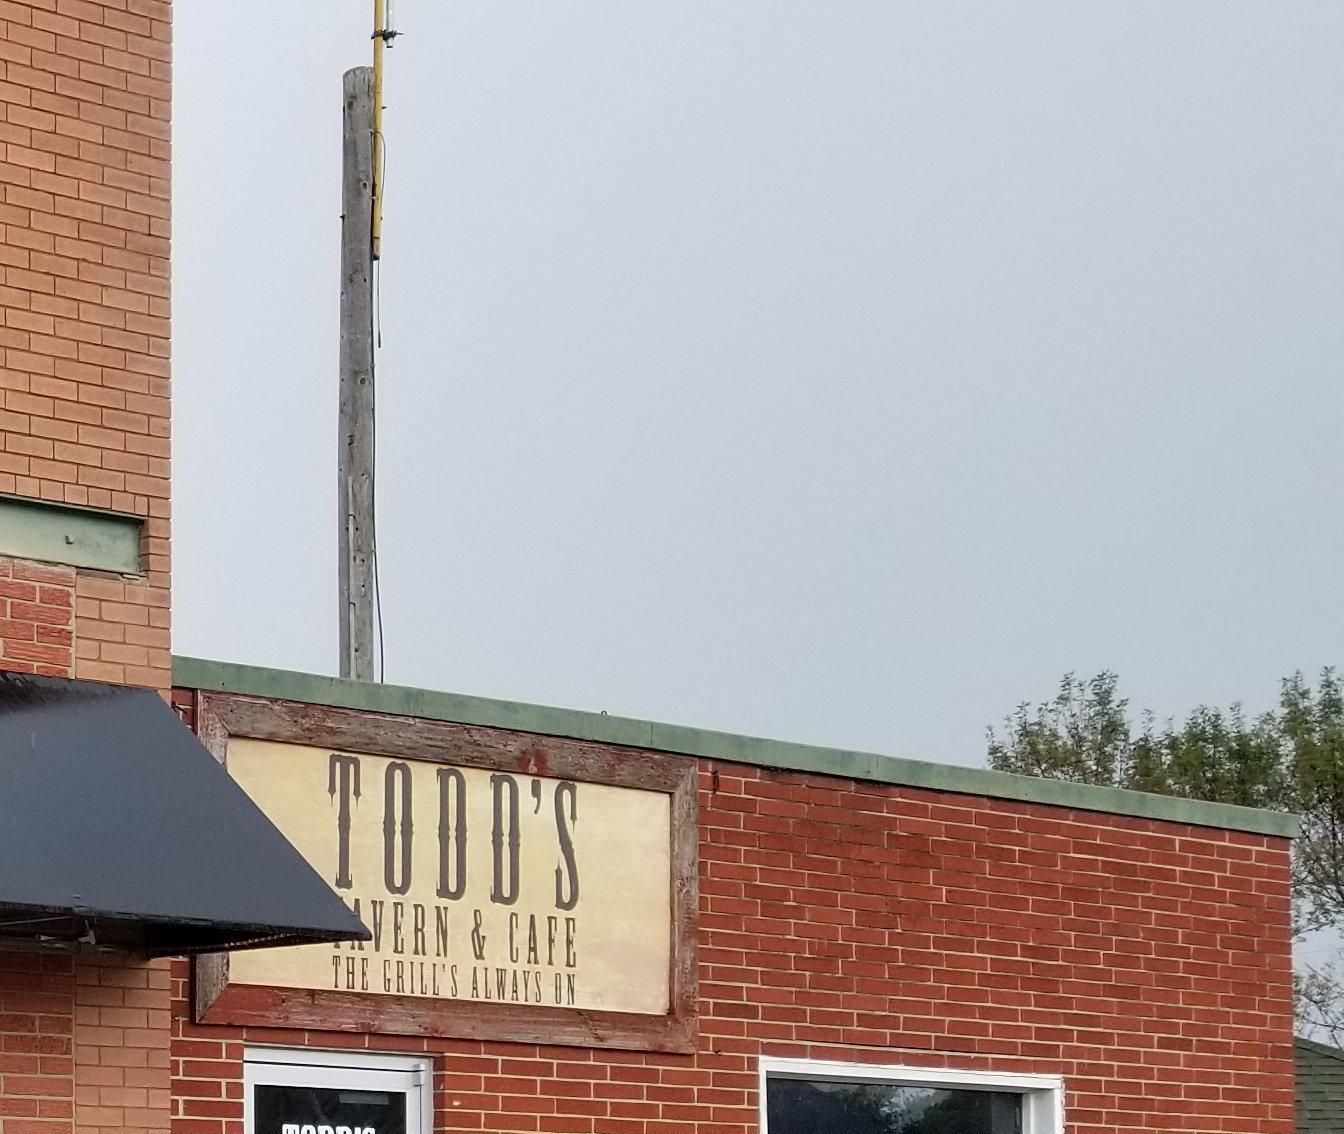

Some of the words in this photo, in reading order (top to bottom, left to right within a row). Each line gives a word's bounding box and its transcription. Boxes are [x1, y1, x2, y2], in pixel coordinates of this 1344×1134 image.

[328, 753, 580, 911] TODD'S
[471, 909, 486, 960] &
[509, 912, 576, 968] CAFE
[332, 955, 369, 991] THE
[383, 959, 458, 997] GRILL'S
[471, 967, 542, 1003] ALWAYS
[555, 972, 575, 1005] ON
